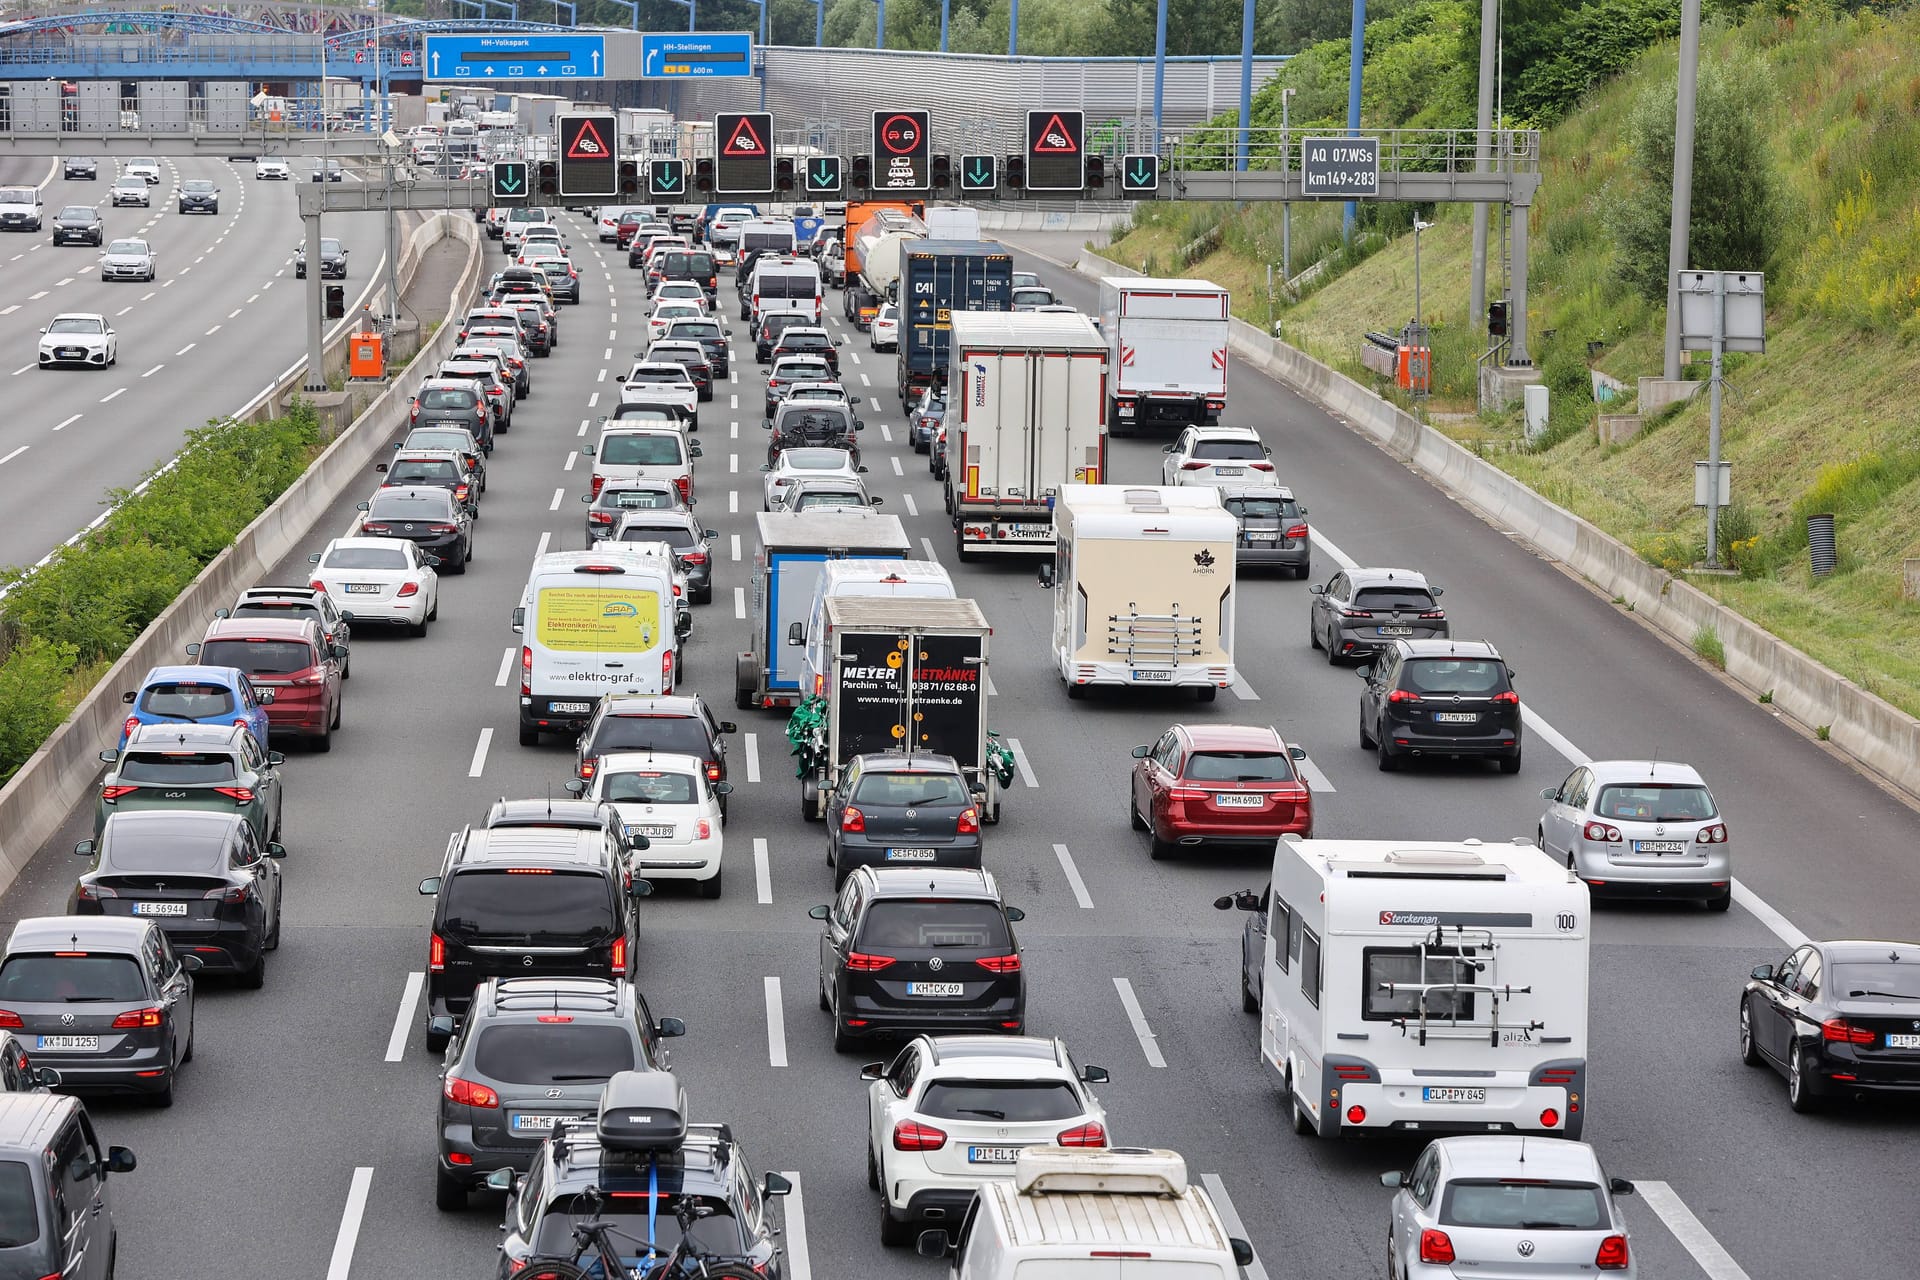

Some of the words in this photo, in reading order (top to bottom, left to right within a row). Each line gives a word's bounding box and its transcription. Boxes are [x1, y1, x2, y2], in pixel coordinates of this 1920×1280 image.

[481, 39, 529, 47] HH-Volkspark
[663, 43, 712, 51] HH-Stellingen
[1311, 148, 1327, 162] AQ
[1333, 148, 1373, 162] 07.WSs
[915, 282, 933, 294] CAI
[938, 310, 949, 321] 45
[1011, 531, 1051, 539] SCHMITZ
[549, 671, 645, 684] www.elektro-graf.de
[843, 667, 896, 680] MEYER
[913, 666, 977, 681] GETRÄNKE
[842, 681, 878, 690] Parchim
[1232, 796, 1242, 804] HA
[662, 828, 673, 836] 89
[1640, 841, 1651, 850] RD
[1656, 841, 1667, 850] HM
[1667, 842, 1682, 851] 234
[892, 849, 902, 858] SE
[141, 904, 151, 912] EE
[155, 904, 184, 913] 56944
[1381, 911, 1440, 926] Sterckeman
[1556, 914, 1575, 929] 100
[915, 983, 928, 993] KH
[934, 984, 946, 994] CK
[948, 985, 960, 994] 69
[44, 1037, 55, 1047] KK
[62, 1037, 73, 1047] DU
[75, 1037, 97, 1047] 1253
[1892, 1036, 1905, 1046] PI
[1429, 1089, 1447, 1100] CLP
[1454, 1090, 1466, 1100] PY
[1467, 1090, 1484, 1100] 845
[520, 1116, 532, 1128] HH
[539, 1117, 551, 1128] ME
[976, 1149, 987, 1159] PI
[994, 1149, 1007, 1160] EL
